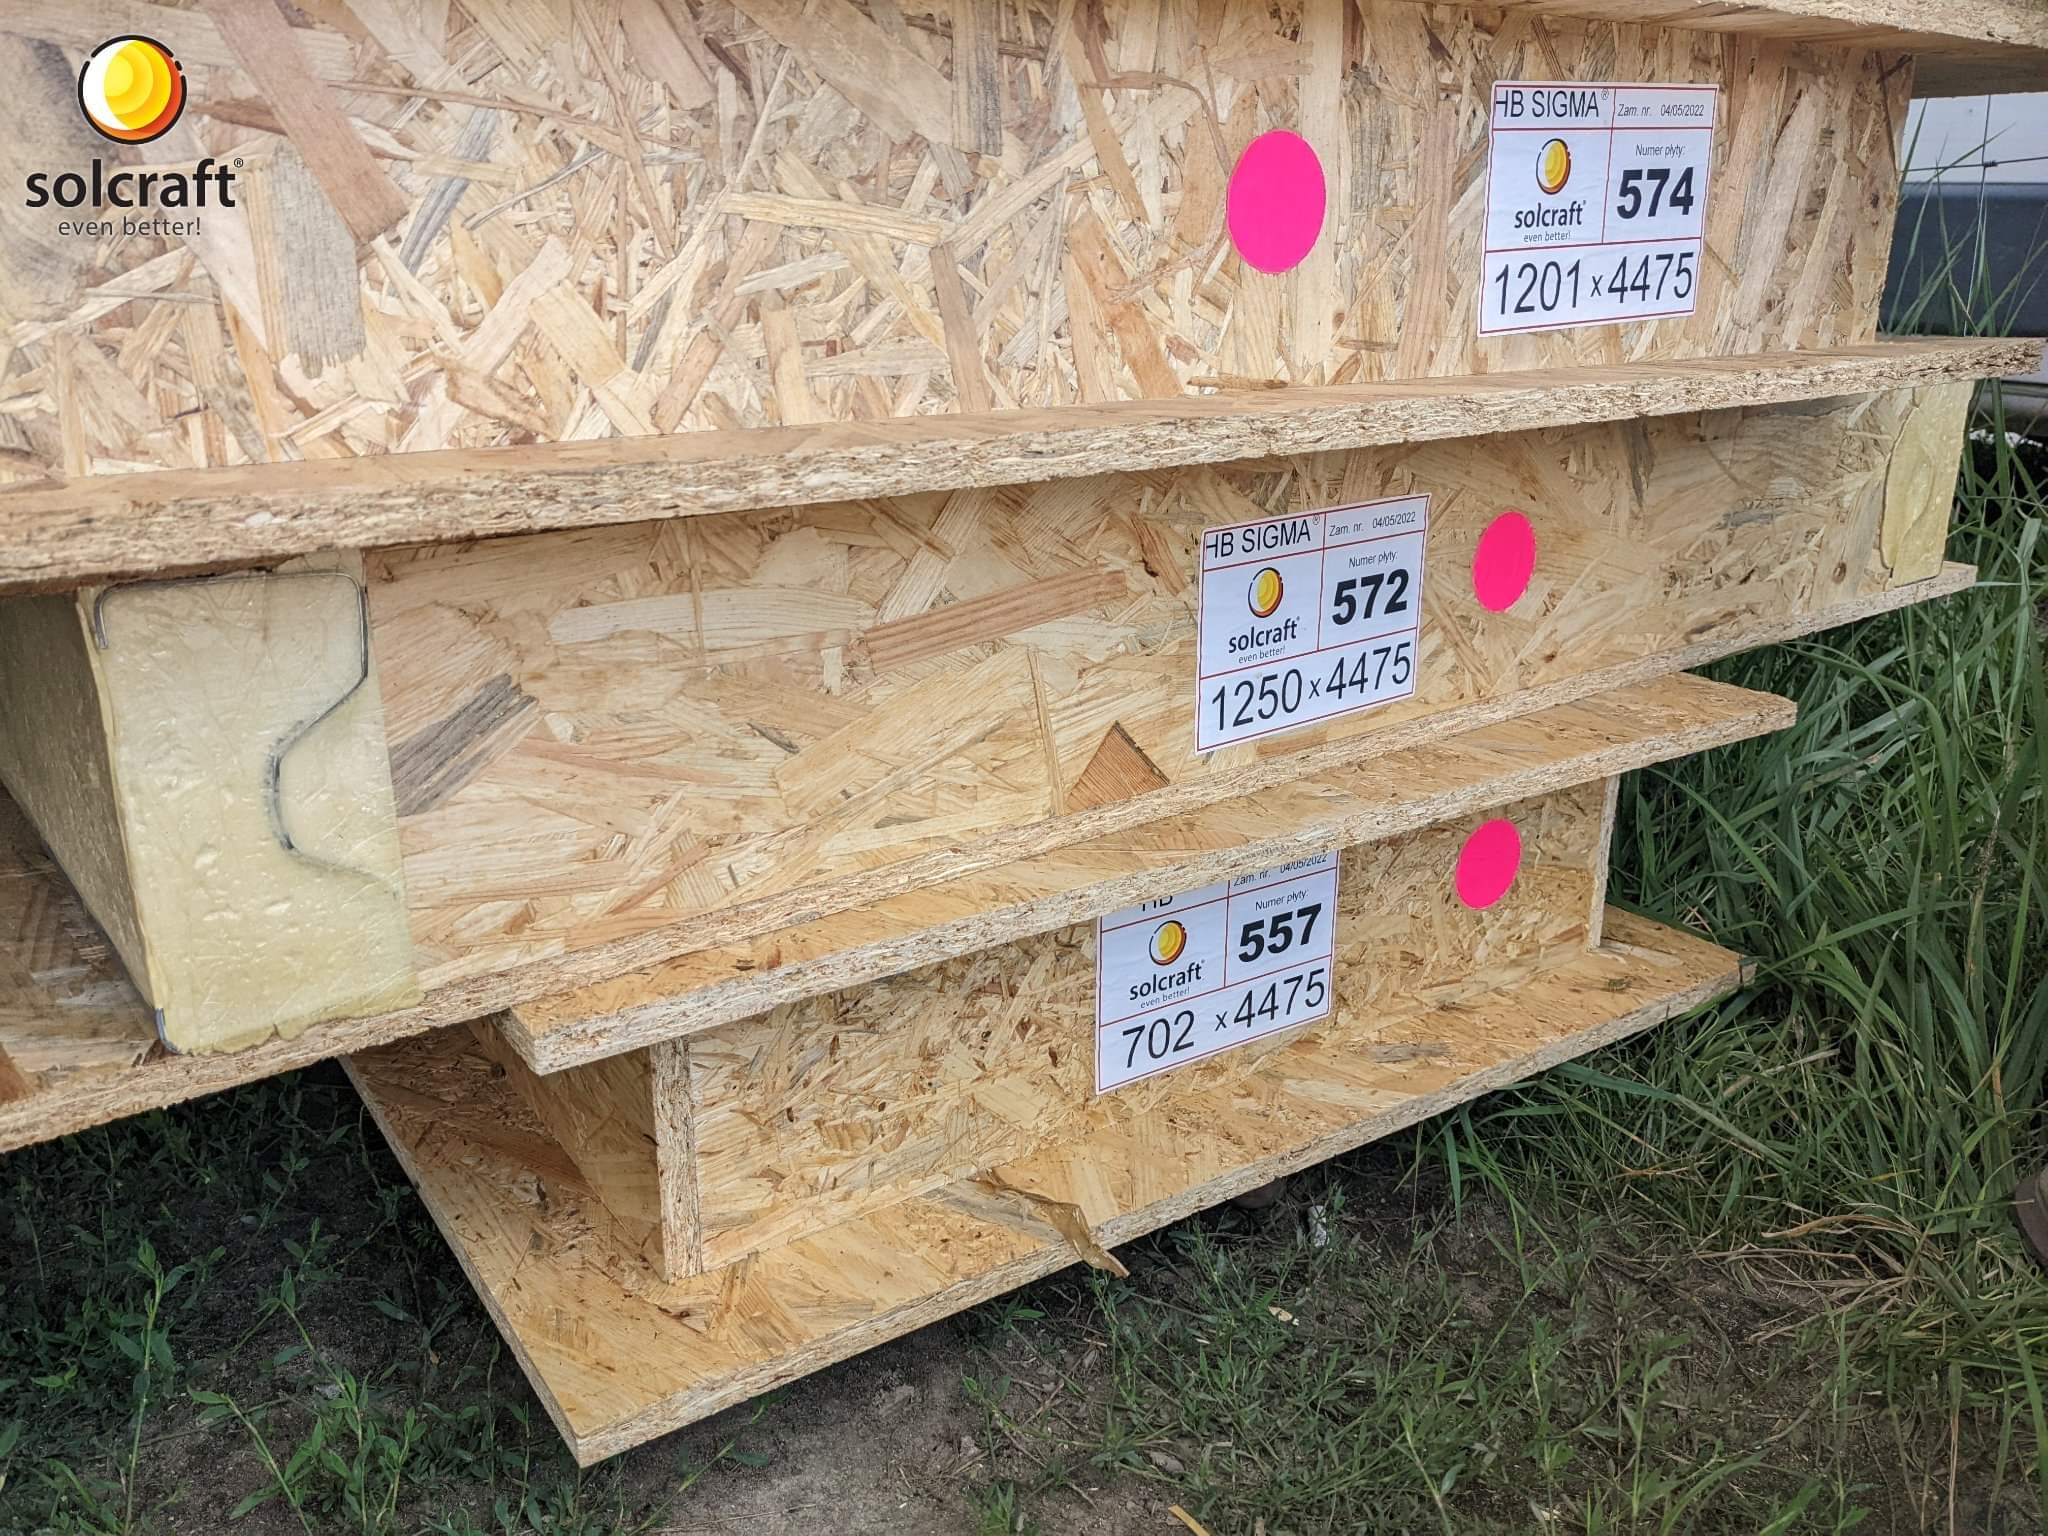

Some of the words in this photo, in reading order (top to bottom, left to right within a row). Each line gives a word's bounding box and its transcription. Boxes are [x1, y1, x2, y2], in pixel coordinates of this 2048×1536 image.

[1617, 104, 1637, 117] Zam.
[1660, 103, 1705, 117] 04/05/2022
[1635, 144, 1663, 157] Numer
[1616, 166, 1696, 219] 574
[1523, 232, 1543, 243] even
[1545, 231, 1571, 242] better!
[1495, 258, 1581, 315] 1201
[1607, 251, 1694, 304] 4475
[1328, 525, 1349, 537] Zam.
[1372, 511, 1416, 529] 04/05/2022
[1349, 553, 1377, 568] Numer
[1332, 568, 1409, 626] 572
[1238, 652, 1258, 664] even
[1259, 645, 1286, 660] better!
[1212, 668, 1303, 731] 1250
[1325, 641, 1411, 700] 4475
[1255, 895, 1285, 911] Numer
[1238, 902, 1323, 963] 557
[1140, 996, 1161, 1009] even
[1162, 986, 1190, 1002] better!
[1122, 1009, 1195, 1069] 702
[1233, 967, 1326, 1028] 4475
